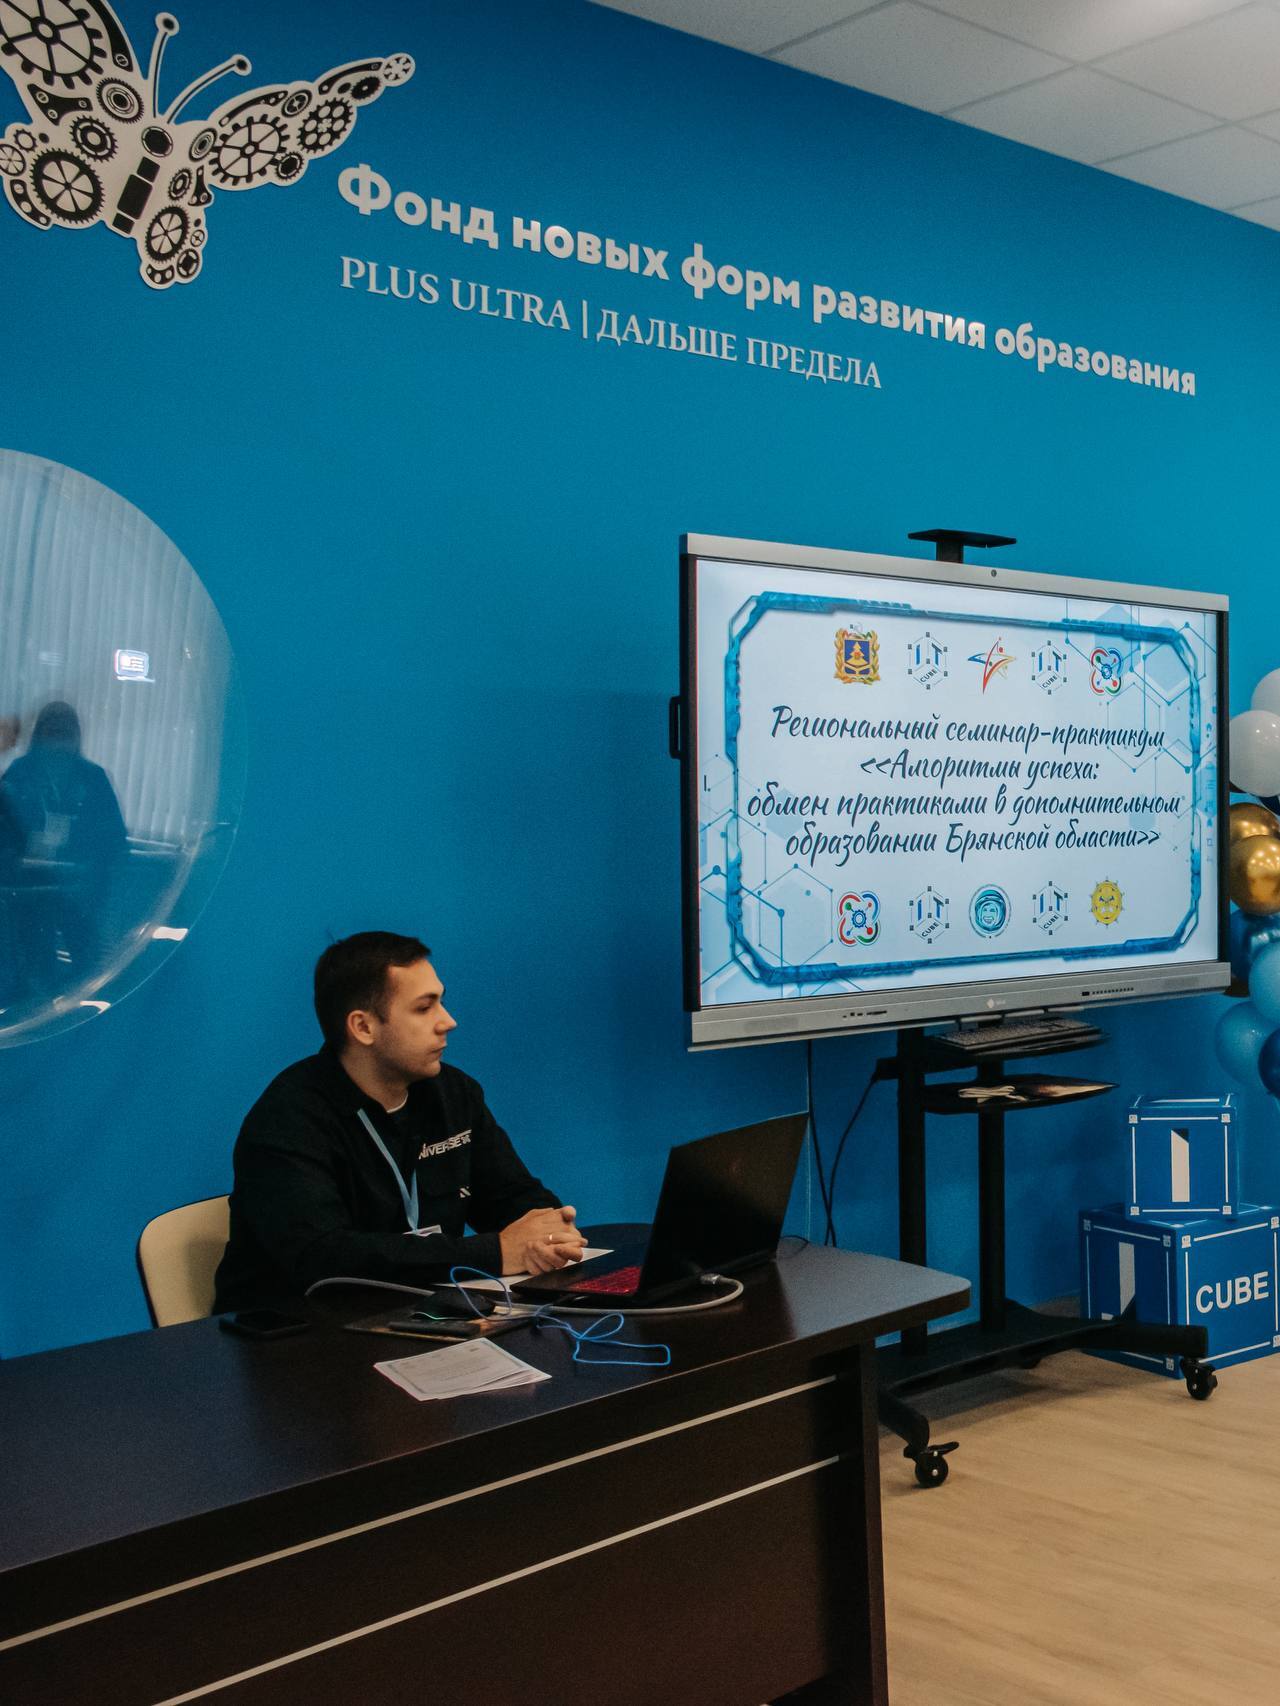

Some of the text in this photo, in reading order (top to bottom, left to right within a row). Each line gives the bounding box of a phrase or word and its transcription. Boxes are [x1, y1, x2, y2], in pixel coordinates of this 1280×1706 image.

[337, 163, 1196, 395] Фонд новых форм развития образования
[340, 255, 440, 305] PLUS
[450, 277, 571, 331] ULTRA
[597, 308, 737, 362] ДАЛЬШЕ
[746, 336, 882, 388] ПРЕДЕЛА
[920, 668, 938, 684] CUBE
[1042, 675, 1058, 689] CUBE
[772, 705, 1165, 757] Региональный семинар-практикум
[1024, 759, 1099, 790] успеха:
[748, 782, 1181, 828] обмен практиками в дополнительном
[786, 821, 938, 868] образовании
[946, 823, 1051, 862] Брянской
[921, 922, 940, 938] CUBE
[1043, 915, 1060, 930] CUBE
[1195, 1271, 1269, 1313] CUBE
